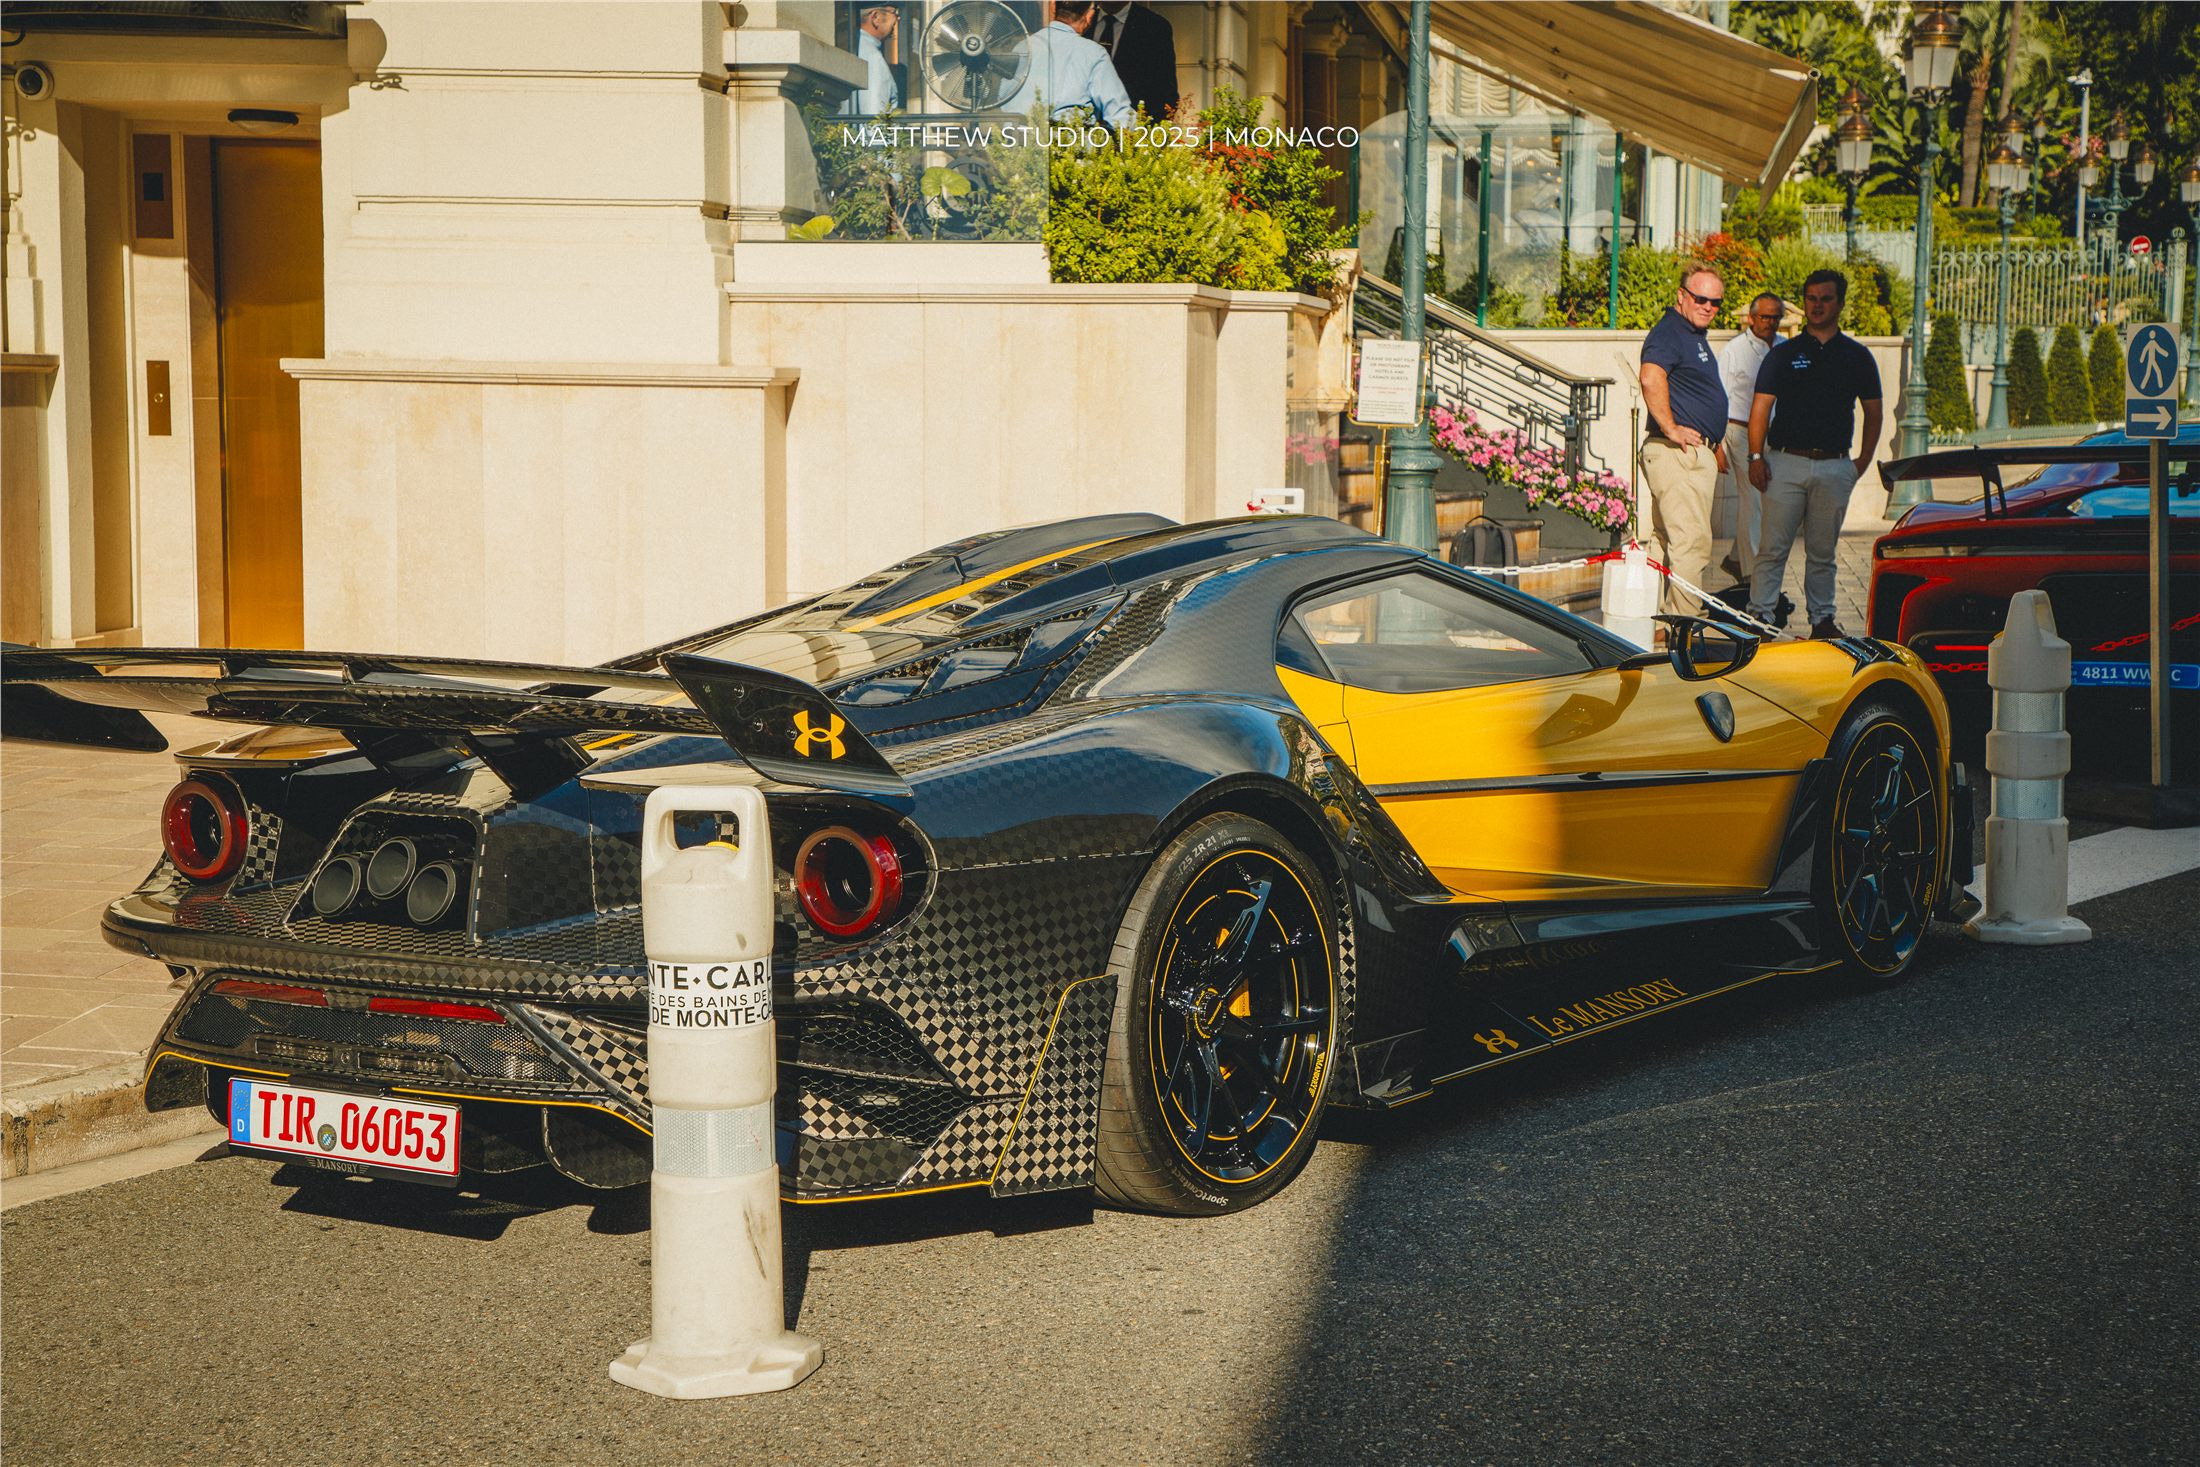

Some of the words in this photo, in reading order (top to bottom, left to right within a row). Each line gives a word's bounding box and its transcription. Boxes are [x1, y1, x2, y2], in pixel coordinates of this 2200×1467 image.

[2082, 667, 2118, 679] 4811
[1191, 843, 1206, 858] ZR
[1205, 835, 1217, 847] 21
[659, 994, 686, 1008] DES
[693, 994, 747, 1008] BAINS
[754, 990, 766, 1003] DE
[1527, 1015, 1574, 1037] Le
[1558, 978, 1688, 1028] MANSORY
[652, 1006, 670, 1026] DE
[237, 1119, 245, 1132] D
[258, 1090, 316, 1145] TIR
[340, 1102, 448, 1163] 06053
[316, 1157, 360, 1175] MANSORY
